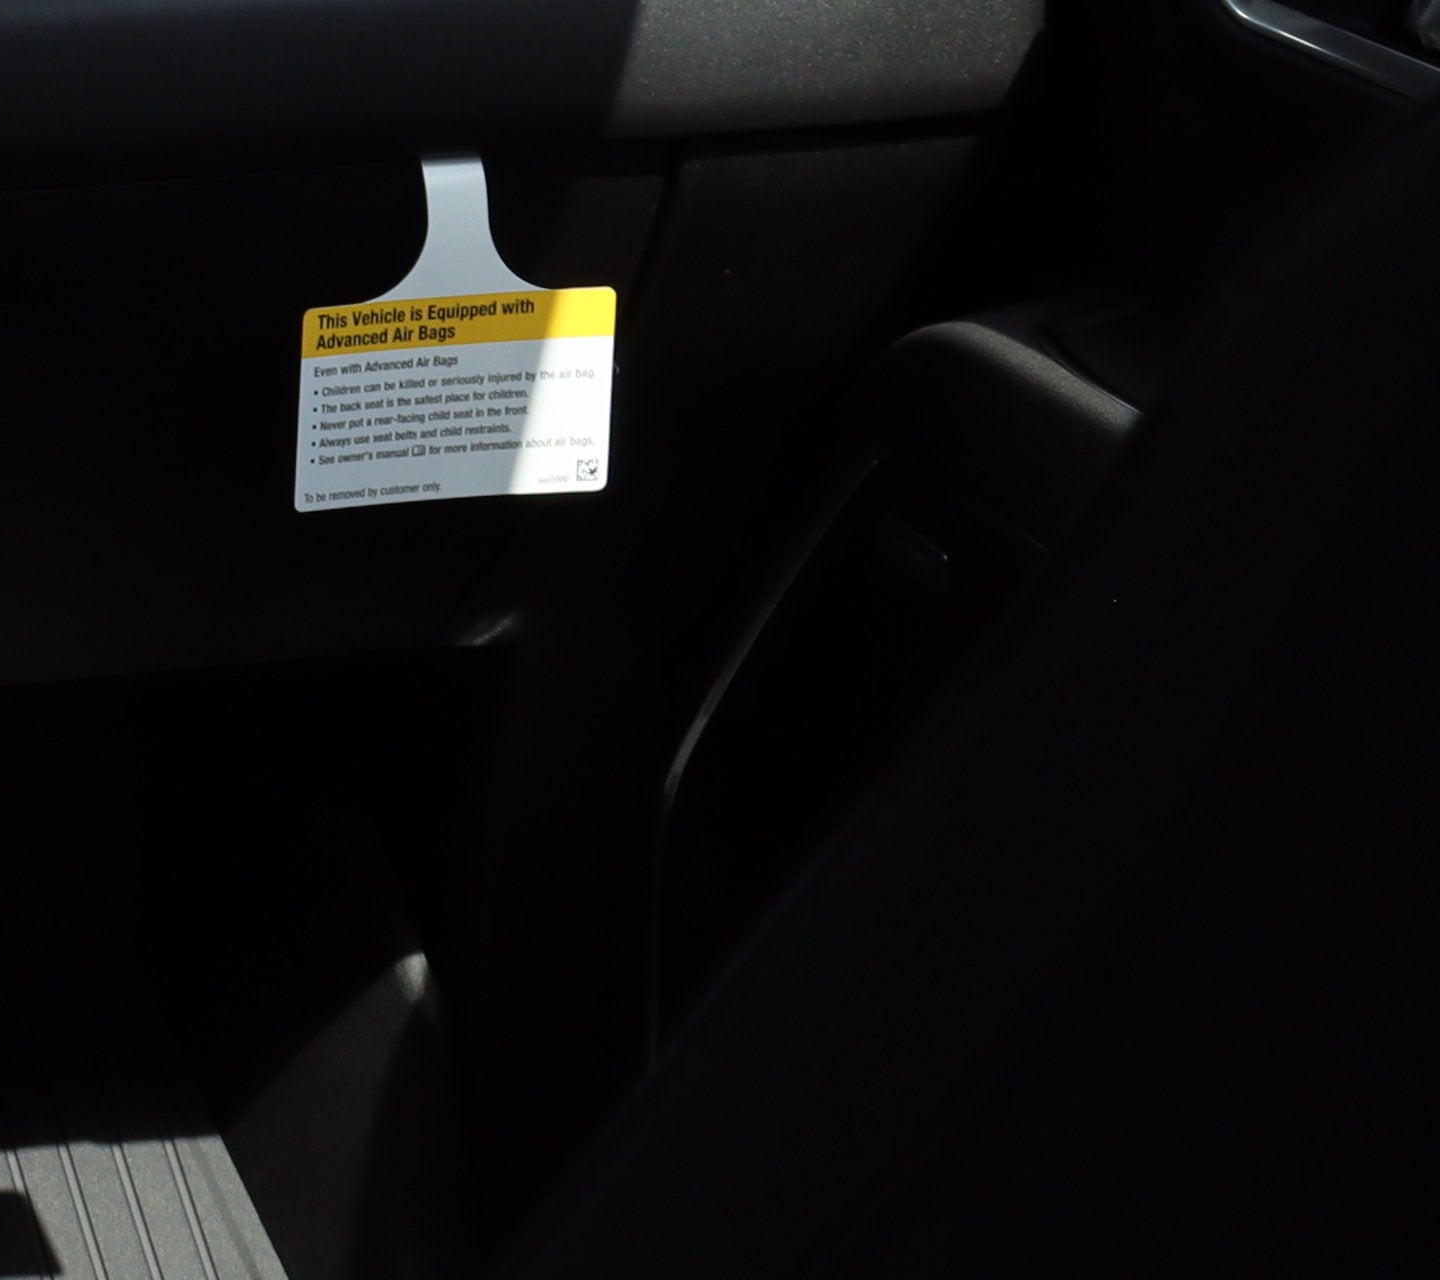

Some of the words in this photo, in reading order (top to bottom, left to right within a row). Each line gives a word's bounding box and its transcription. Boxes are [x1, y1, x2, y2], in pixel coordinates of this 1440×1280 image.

[318, 313, 347, 330] This
[352, 307, 406, 327] Vehicle
[410, 306, 423, 322] is
[427, 301, 497, 324] Equipped
[501, 299, 535, 315] with
[316, 329, 388, 350] Advanced
[392, 327, 414, 343] Air
[418, 324, 456, 343] Bags
[313, 366, 338, 378] Even
[340, 362, 362, 374] with
[364, 358, 414, 372] Advanced
[415, 356, 430, 367] Air
[432, 355, 458, 368] Bags
[320, 403, 337, 414] The
[339, 400, 362, 412] back
[364, 398, 384, 410] seat
[386, 398, 394, 408] is
[396, 396, 412, 407] the
[414, 393, 442, 406] safest
[444, 392, 470, 404] place
[472, 390, 486, 401] for
[487, 388, 529, 400] children.
[303, 492, 314, 503] To
[315, 492, 326, 502] be
[328, 487, 365, 500] removed
[367, 487, 378, 498] by
[379, 484, 420, 496] customer
[421, 481, 440, 493] only.
